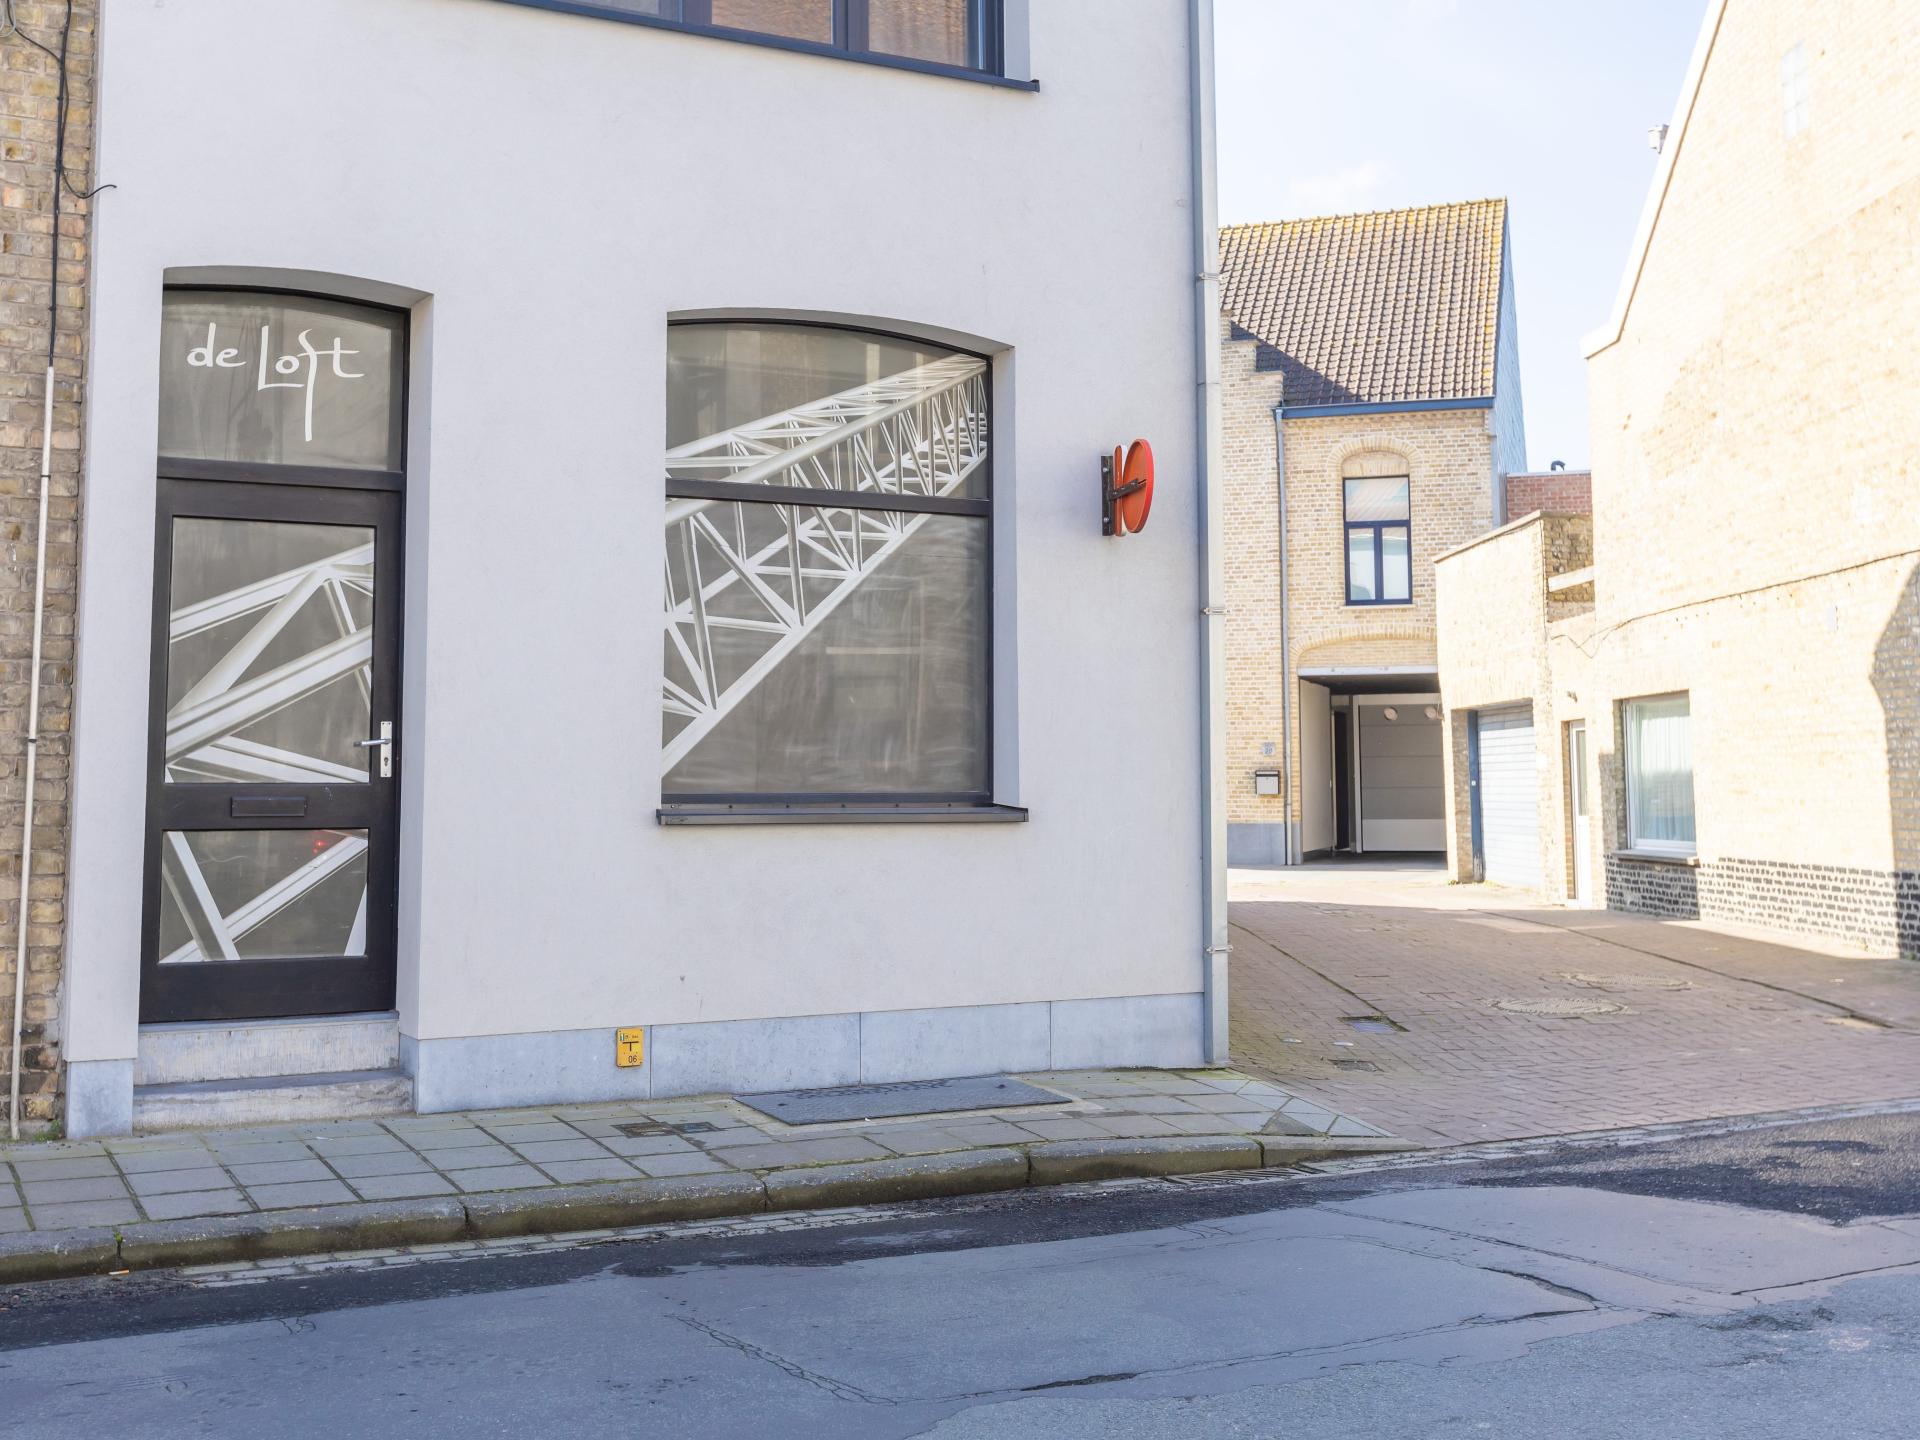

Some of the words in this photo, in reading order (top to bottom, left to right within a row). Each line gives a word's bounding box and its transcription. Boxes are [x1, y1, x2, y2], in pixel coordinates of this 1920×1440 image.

[187, 322, 247, 367] de
[258, 325, 365, 441] Loft
[628, 1055, 638, 1064] 06
